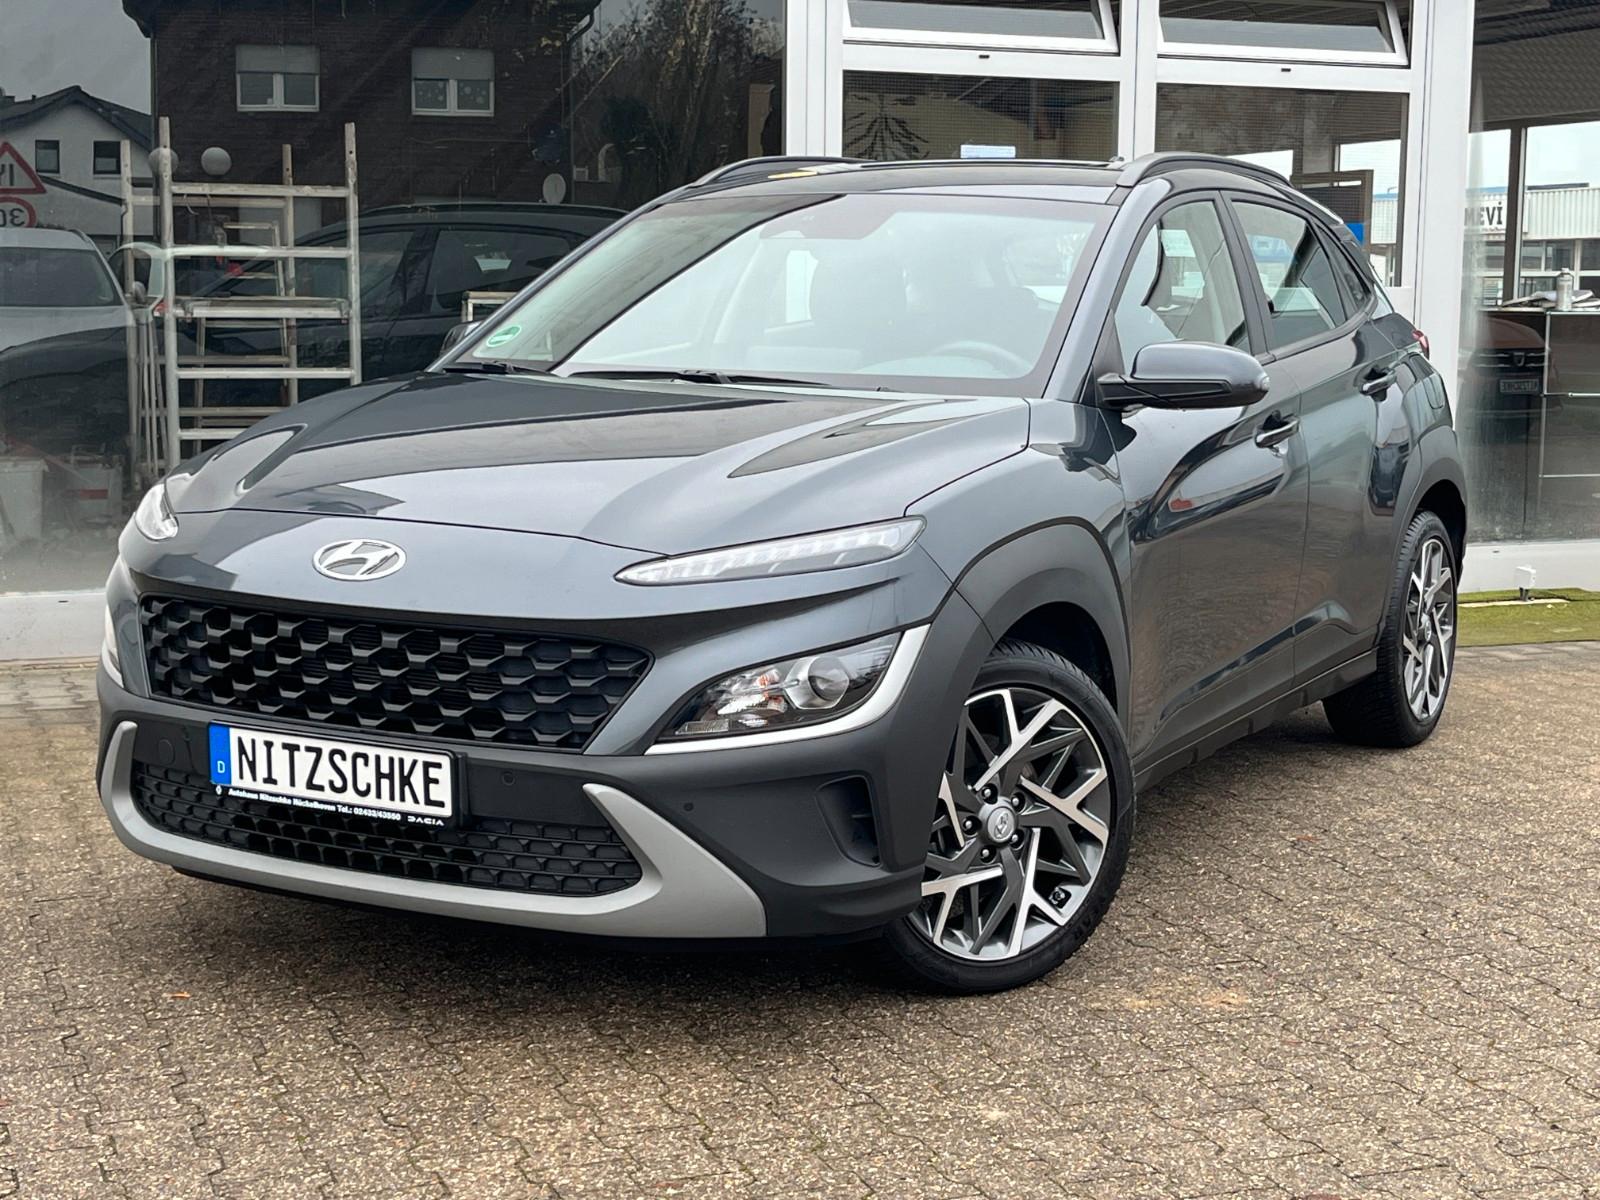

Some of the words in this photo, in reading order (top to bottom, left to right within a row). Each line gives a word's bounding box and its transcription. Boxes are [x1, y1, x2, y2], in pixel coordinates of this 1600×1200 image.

[217, 760, 225, 774] D
[237, 736, 445, 808] NITZSCHKE
[407, 815, 445, 827] DACIA
